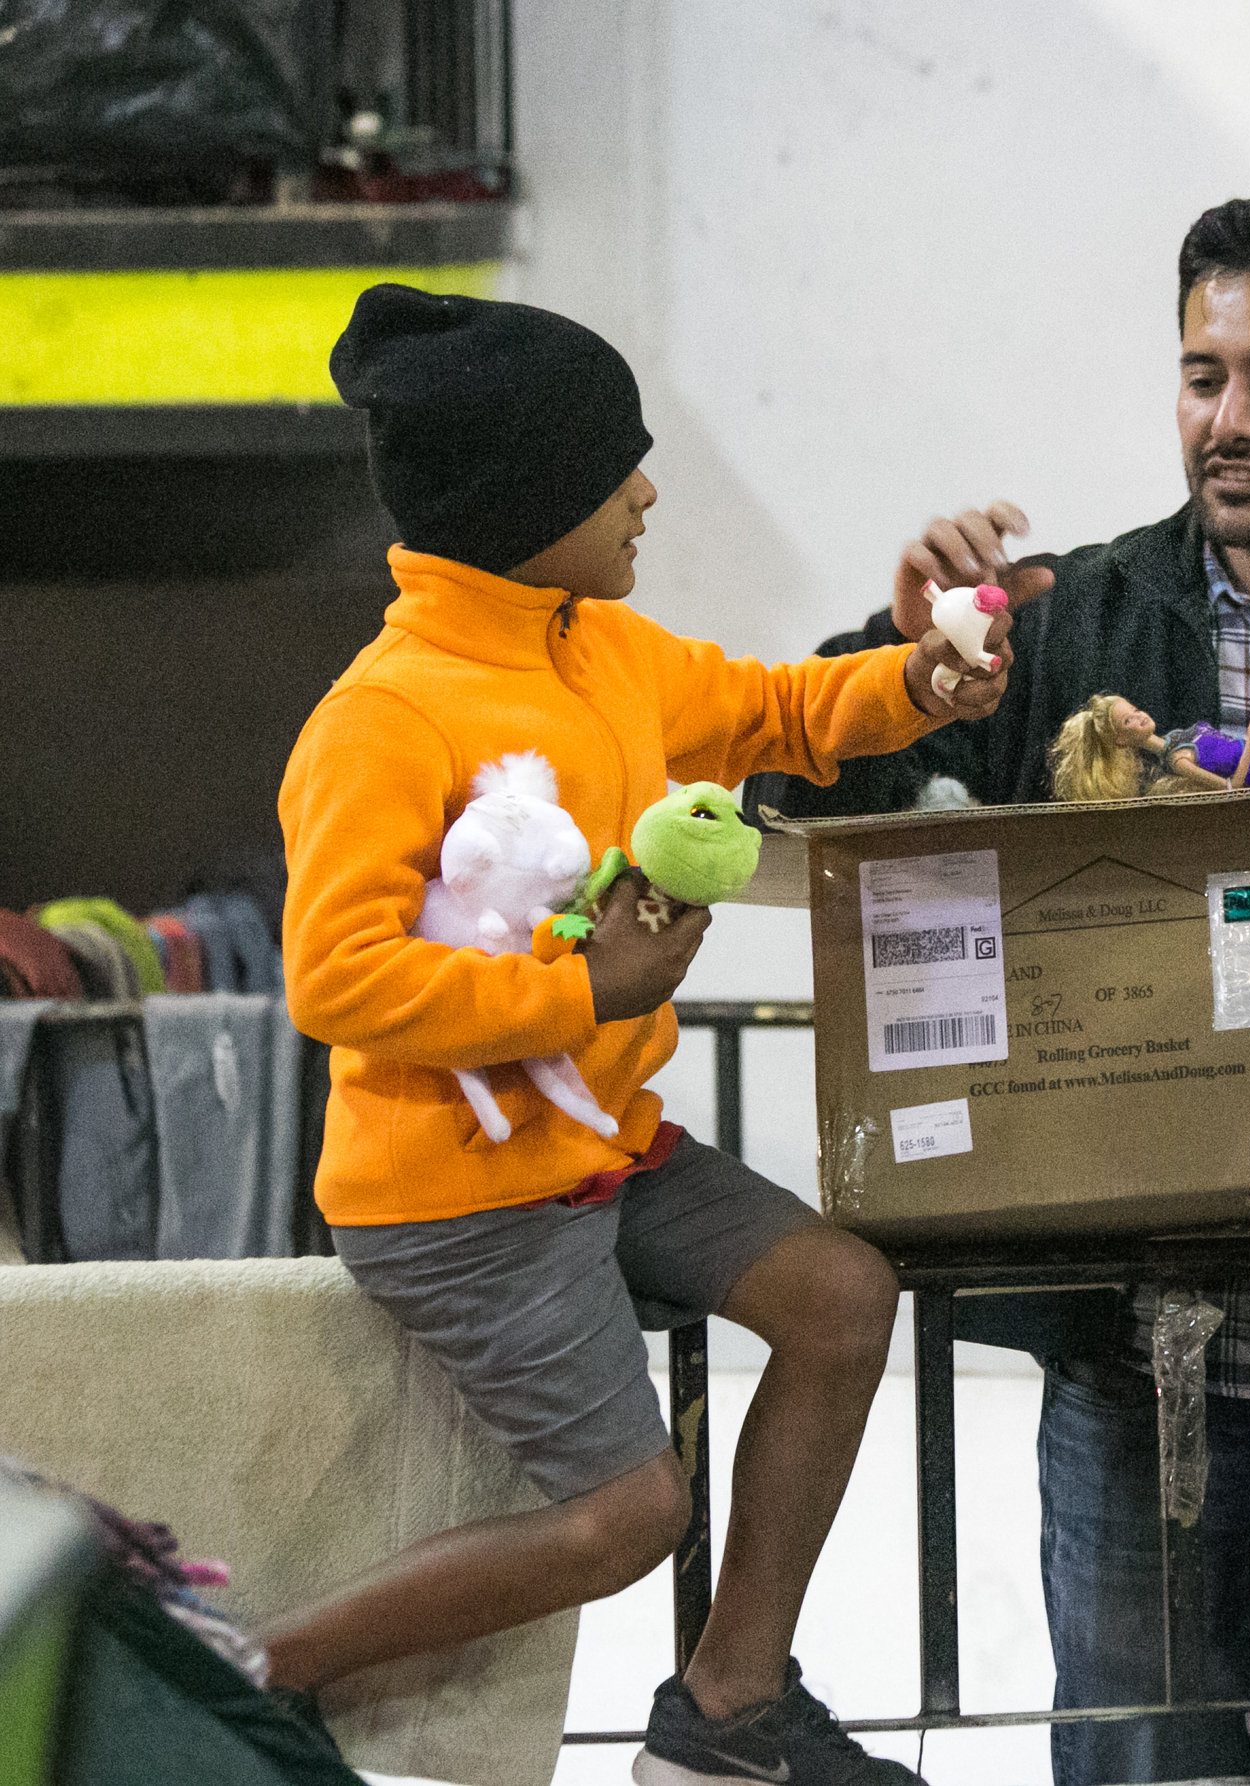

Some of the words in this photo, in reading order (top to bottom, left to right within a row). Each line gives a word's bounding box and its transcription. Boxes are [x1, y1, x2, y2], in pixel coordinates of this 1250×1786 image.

[1039, 908, 1083, 922] Melissa
[1086, 905, 1096, 918] &
[1101, 903, 1133, 918] Doug
[1139, 899, 1166, 914] LLC
[979, 940, 993, 956] G
[1095, 987, 1116, 1002] OF
[1123, 985, 1154, 1001] 3865
[1016, 1022, 1033, 1037] IN
[1034, 1019, 1084, 1036] CHINA
[1037, 1048, 1086, 1064] Rolling
[1089, 1043, 1142, 1059] Grocery
[1145, 1037, 1191, 1054] Basket
[970, 1081, 1005, 1097] GCC
[1008, 1077, 1046, 1094] found
[1048, 1078, 1062, 1091] at
[1064, 1063, 1246, 1089] www.MelissaAndDoug.com
